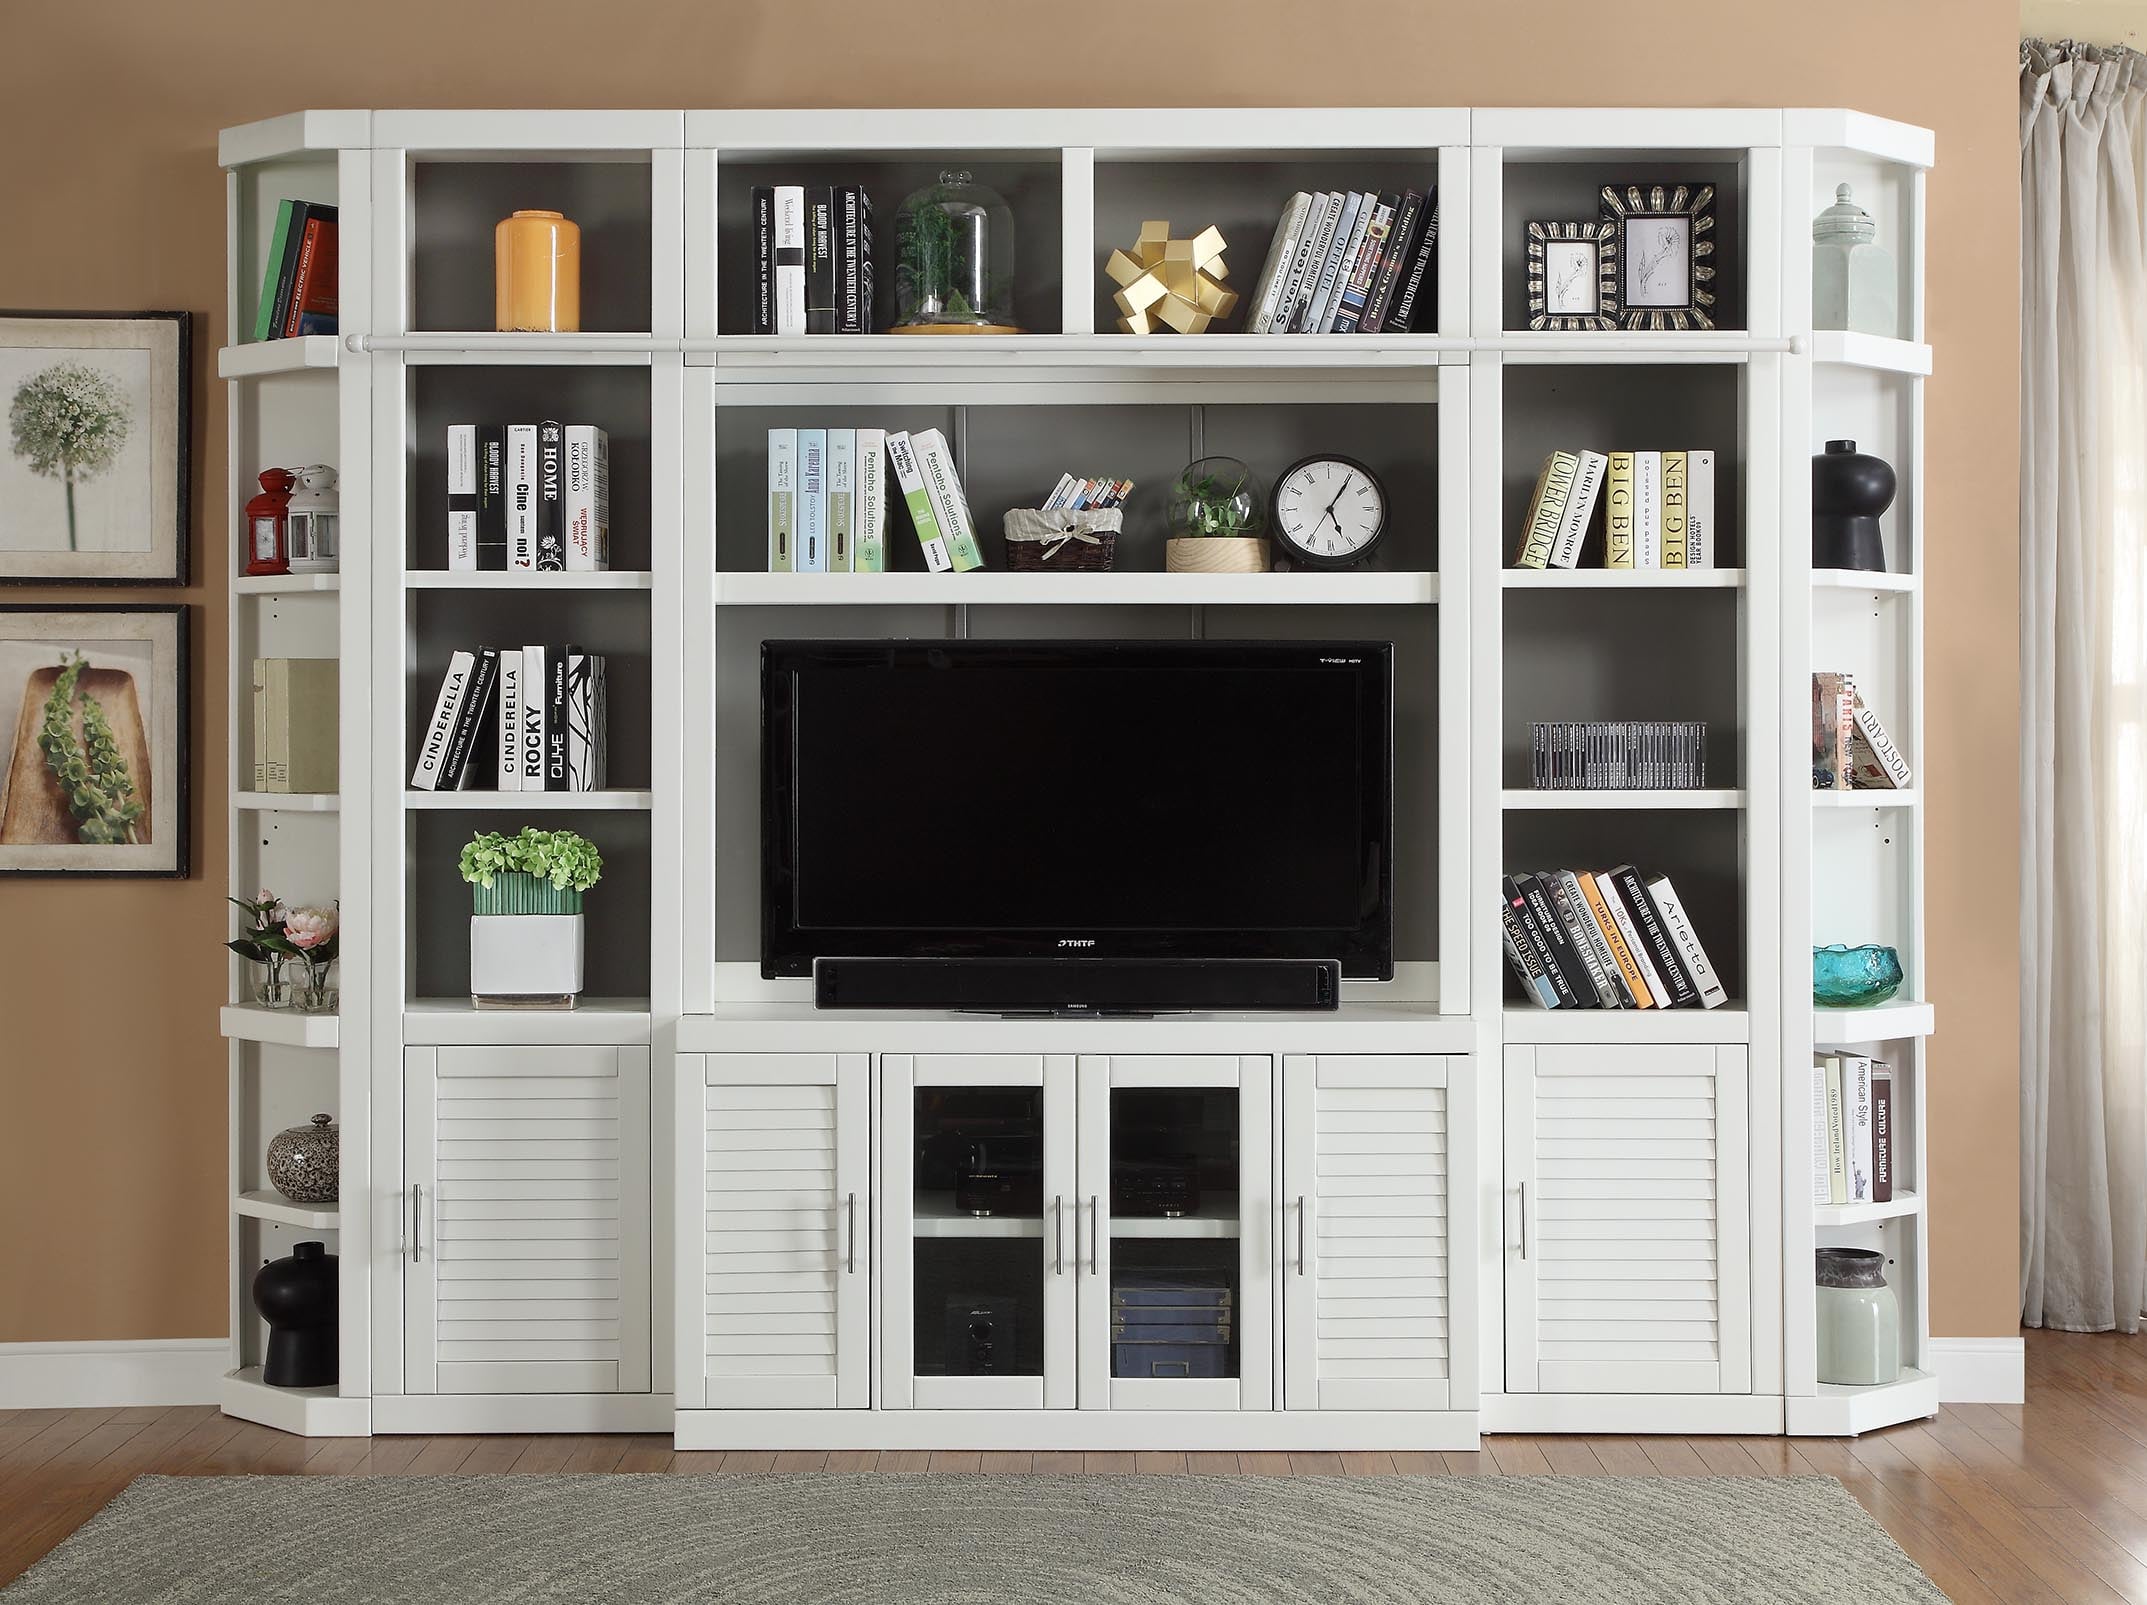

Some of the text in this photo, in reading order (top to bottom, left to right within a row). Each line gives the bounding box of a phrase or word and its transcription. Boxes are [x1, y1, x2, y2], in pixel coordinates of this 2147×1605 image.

[784, 198, 793, 226] Weekend
[817, 204, 828, 259] BLOODY HARVEST
[1327, 198, 1340, 220] CREATE
[1350, 212, 1367, 249] GUCCI
[846, 246, 856, 258] THE
[1315, 222, 1333, 258] WONDERFUL
[1419, 246, 1430, 259] THE
[296, 270, 306, 300] ELECTRIC
[302, 240, 311, 267] VEHICLE
[846, 259, 857, 294] TWENTIETH
[1304, 260, 1320, 290] HOMELIFE
[1320, 237, 1345, 291] OFFICIEL
[1407, 258, 1426, 292] TWENTIETH
[846, 295, 857, 322] CENTURY
[1326, 281, 1343, 319] GUCCI
[1370, 294, 1383, 319] Bride
[1398, 291, 1414, 319] CENTURY
[489, 442, 499, 495] BLOODY HARVEST
[543, 447, 558, 501] HOME
[571, 442, 580, 492] KOŁODKO
[804, 448, 820, 493] Anna Karenina
[867, 452, 876, 492] Pentaho
[894, 454, 906, 470] Mac
[898, 440, 913, 473] Switching
[517, 484, 529, 511] Cine
[928, 452, 946, 491] Pentaho
[943, 494, 962, 536] Solutions
[1525, 452, 1577, 567] TOWER BRIDGE
[1561, 458, 1598, 562] MARILYN MONROE
[1612, 456, 1629, 564] BIG BEN
[1666, 457, 1683, 566] BIG BEN
[579, 508, 588, 557] WĘDRUJĄCY
[866, 496, 876, 539] Solutions
[555, 662, 563, 705] Furniture
[424, 674, 463, 770] CINDERELLA
[448, 737, 465, 777] ARCHITECTURE
[463, 717, 471, 727] THE
[477, 659, 489, 685] CENTURY
[505, 670, 516, 773] CINDERELLA
[1842, 690, 1852, 731] PARIS
[526, 705, 541, 777] ROCKY
[1862, 711, 1908, 780] POSTCARD
[1528, 892, 1538, 907] IDEA
[1536, 907, 1547, 924] BOOK
[1534, 890, 1564, 944] FURNITURE DESIGN
[1565, 881, 1612, 966] CREATE WONDERFUL HOMELIFE
[1643, 915, 1654, 924] IN
[1647, 922, 1660, 935] THE
[1499, 907, 1541, 977] THE SPEED ISSUE
[1523, 913, 1569, 995] TOO GOOD TO BE TRUE
[1570, 925, 1609, 989] BONESHAKER
[1595, 902, 1638, 981] TURKS IN EUROPE
[1627, 930, 1641, 953] Personal
[1638, 953, 1652, 977] Branding
[1653, 933, 1675, 966] TWENTIETH
[1668, 965, 1687, 991] CENTURY
[1856, 1061, 1869, 1127] American Style
[1878, 1099, 1887, 1183] FURNITURE CULTURE
[1833, 1157, 1841, 1175] How
